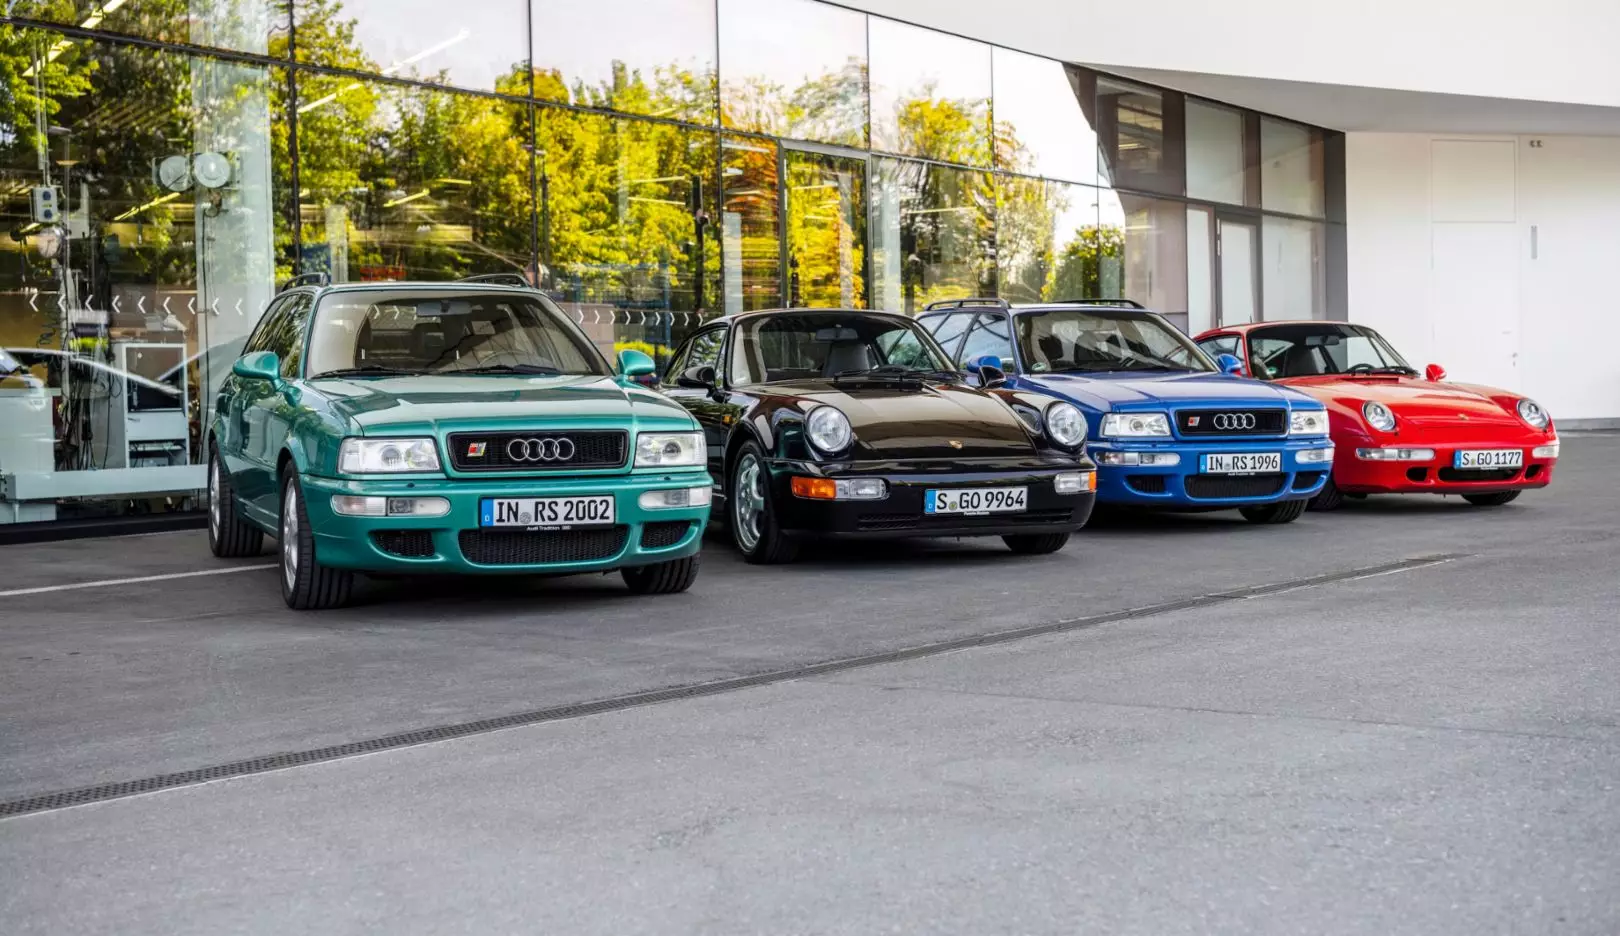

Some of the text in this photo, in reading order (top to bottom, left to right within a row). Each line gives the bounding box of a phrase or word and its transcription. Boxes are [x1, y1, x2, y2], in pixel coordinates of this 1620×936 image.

[1208, 455, 1278, 471] IN RS 1996
[1462, 451, 1521, 466] S GO 1177
[936, 490, 1024, 510] S GO 9964
[496, 499, 610, 523] IN RS 2002
